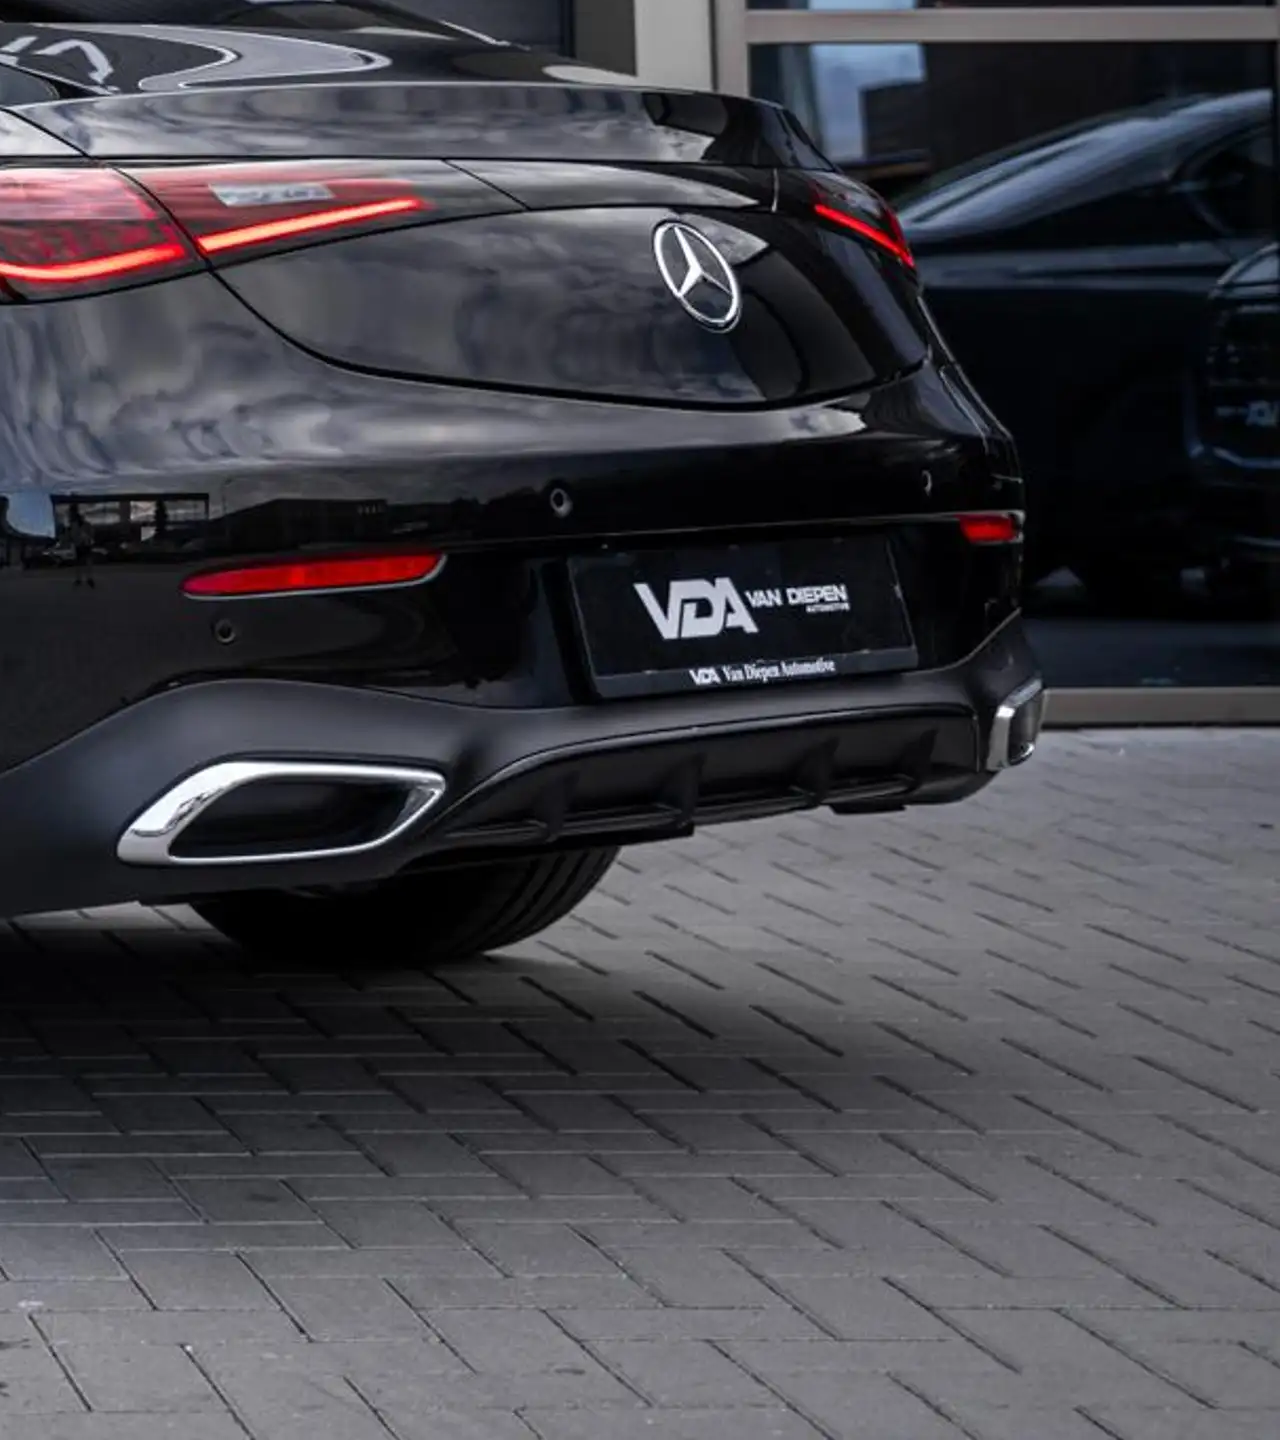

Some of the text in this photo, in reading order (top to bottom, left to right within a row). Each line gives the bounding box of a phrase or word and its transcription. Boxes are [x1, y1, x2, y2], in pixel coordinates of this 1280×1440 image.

[632, 576, 760, 640] VDA
[744, 584, 848, 608] VAN DIEPEN
[688, 656, 836, 685] VDA Van Diepen Automotive
